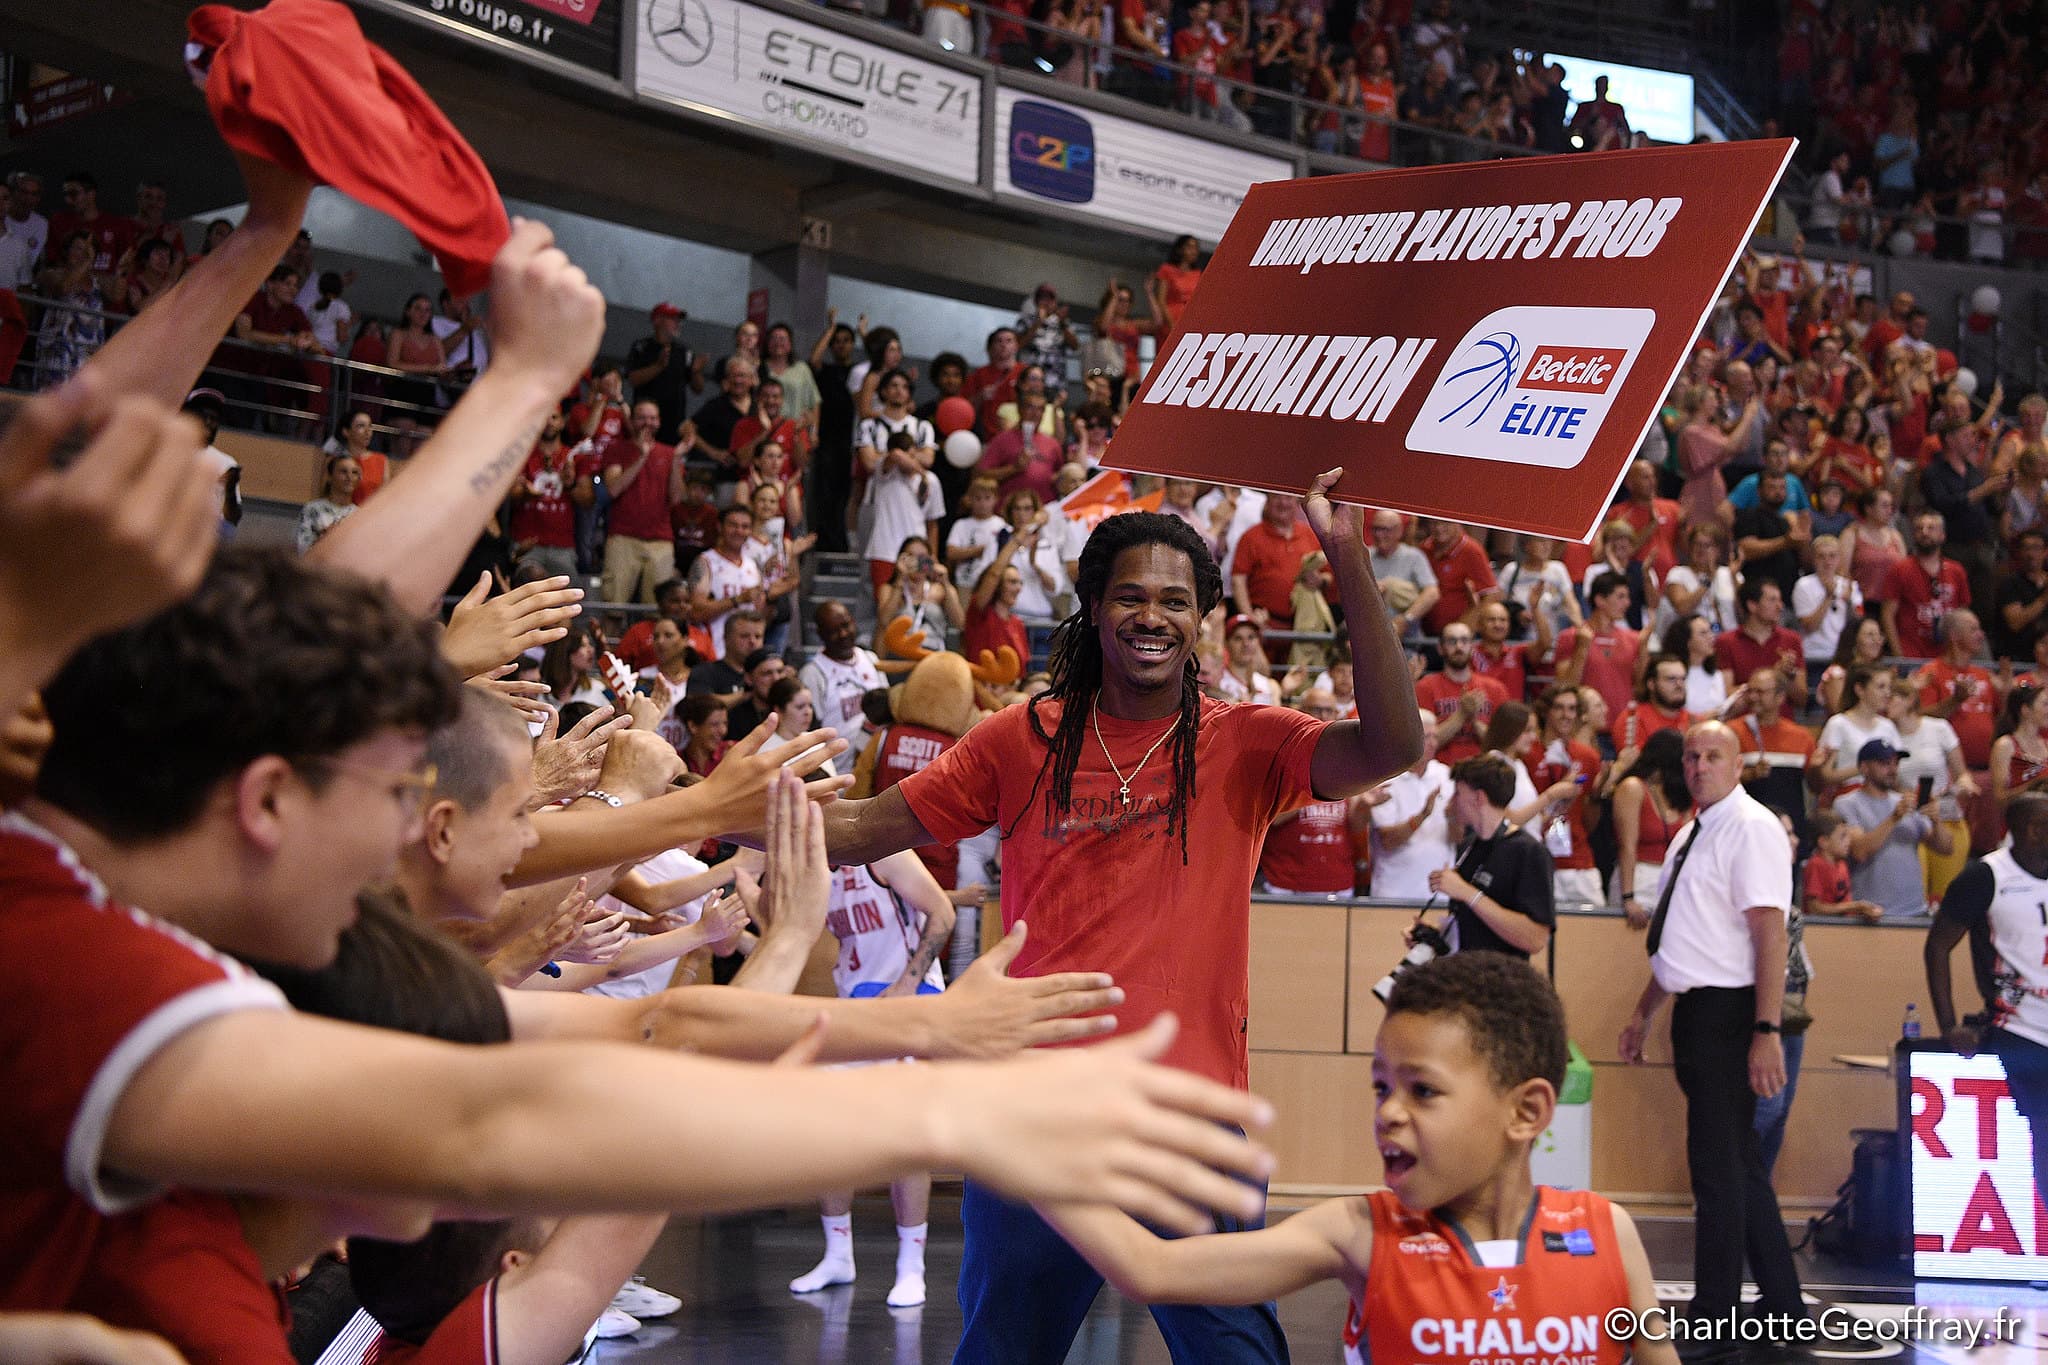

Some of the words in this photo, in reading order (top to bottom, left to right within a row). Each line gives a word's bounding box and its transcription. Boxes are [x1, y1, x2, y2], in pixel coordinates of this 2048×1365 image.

[764, 29, 921, 104] ETOILE
[936, 80, 972, 120] 71
[762, 90, 869, 138] CHOPARD
[1248, 211, 1415, 275] VAINQUEUR
[1394, 201, 1572, 262] PLAYOFFS
[1549, 197, 1682, 259] PROB
[1142, 332, 1439, 423] DESTINATION
[1526, 353, 1613, 386] Betclic
[1500, 395, 1588, 440] ÉLITE
[1410, 1316, 1599, 1355] CHALON
